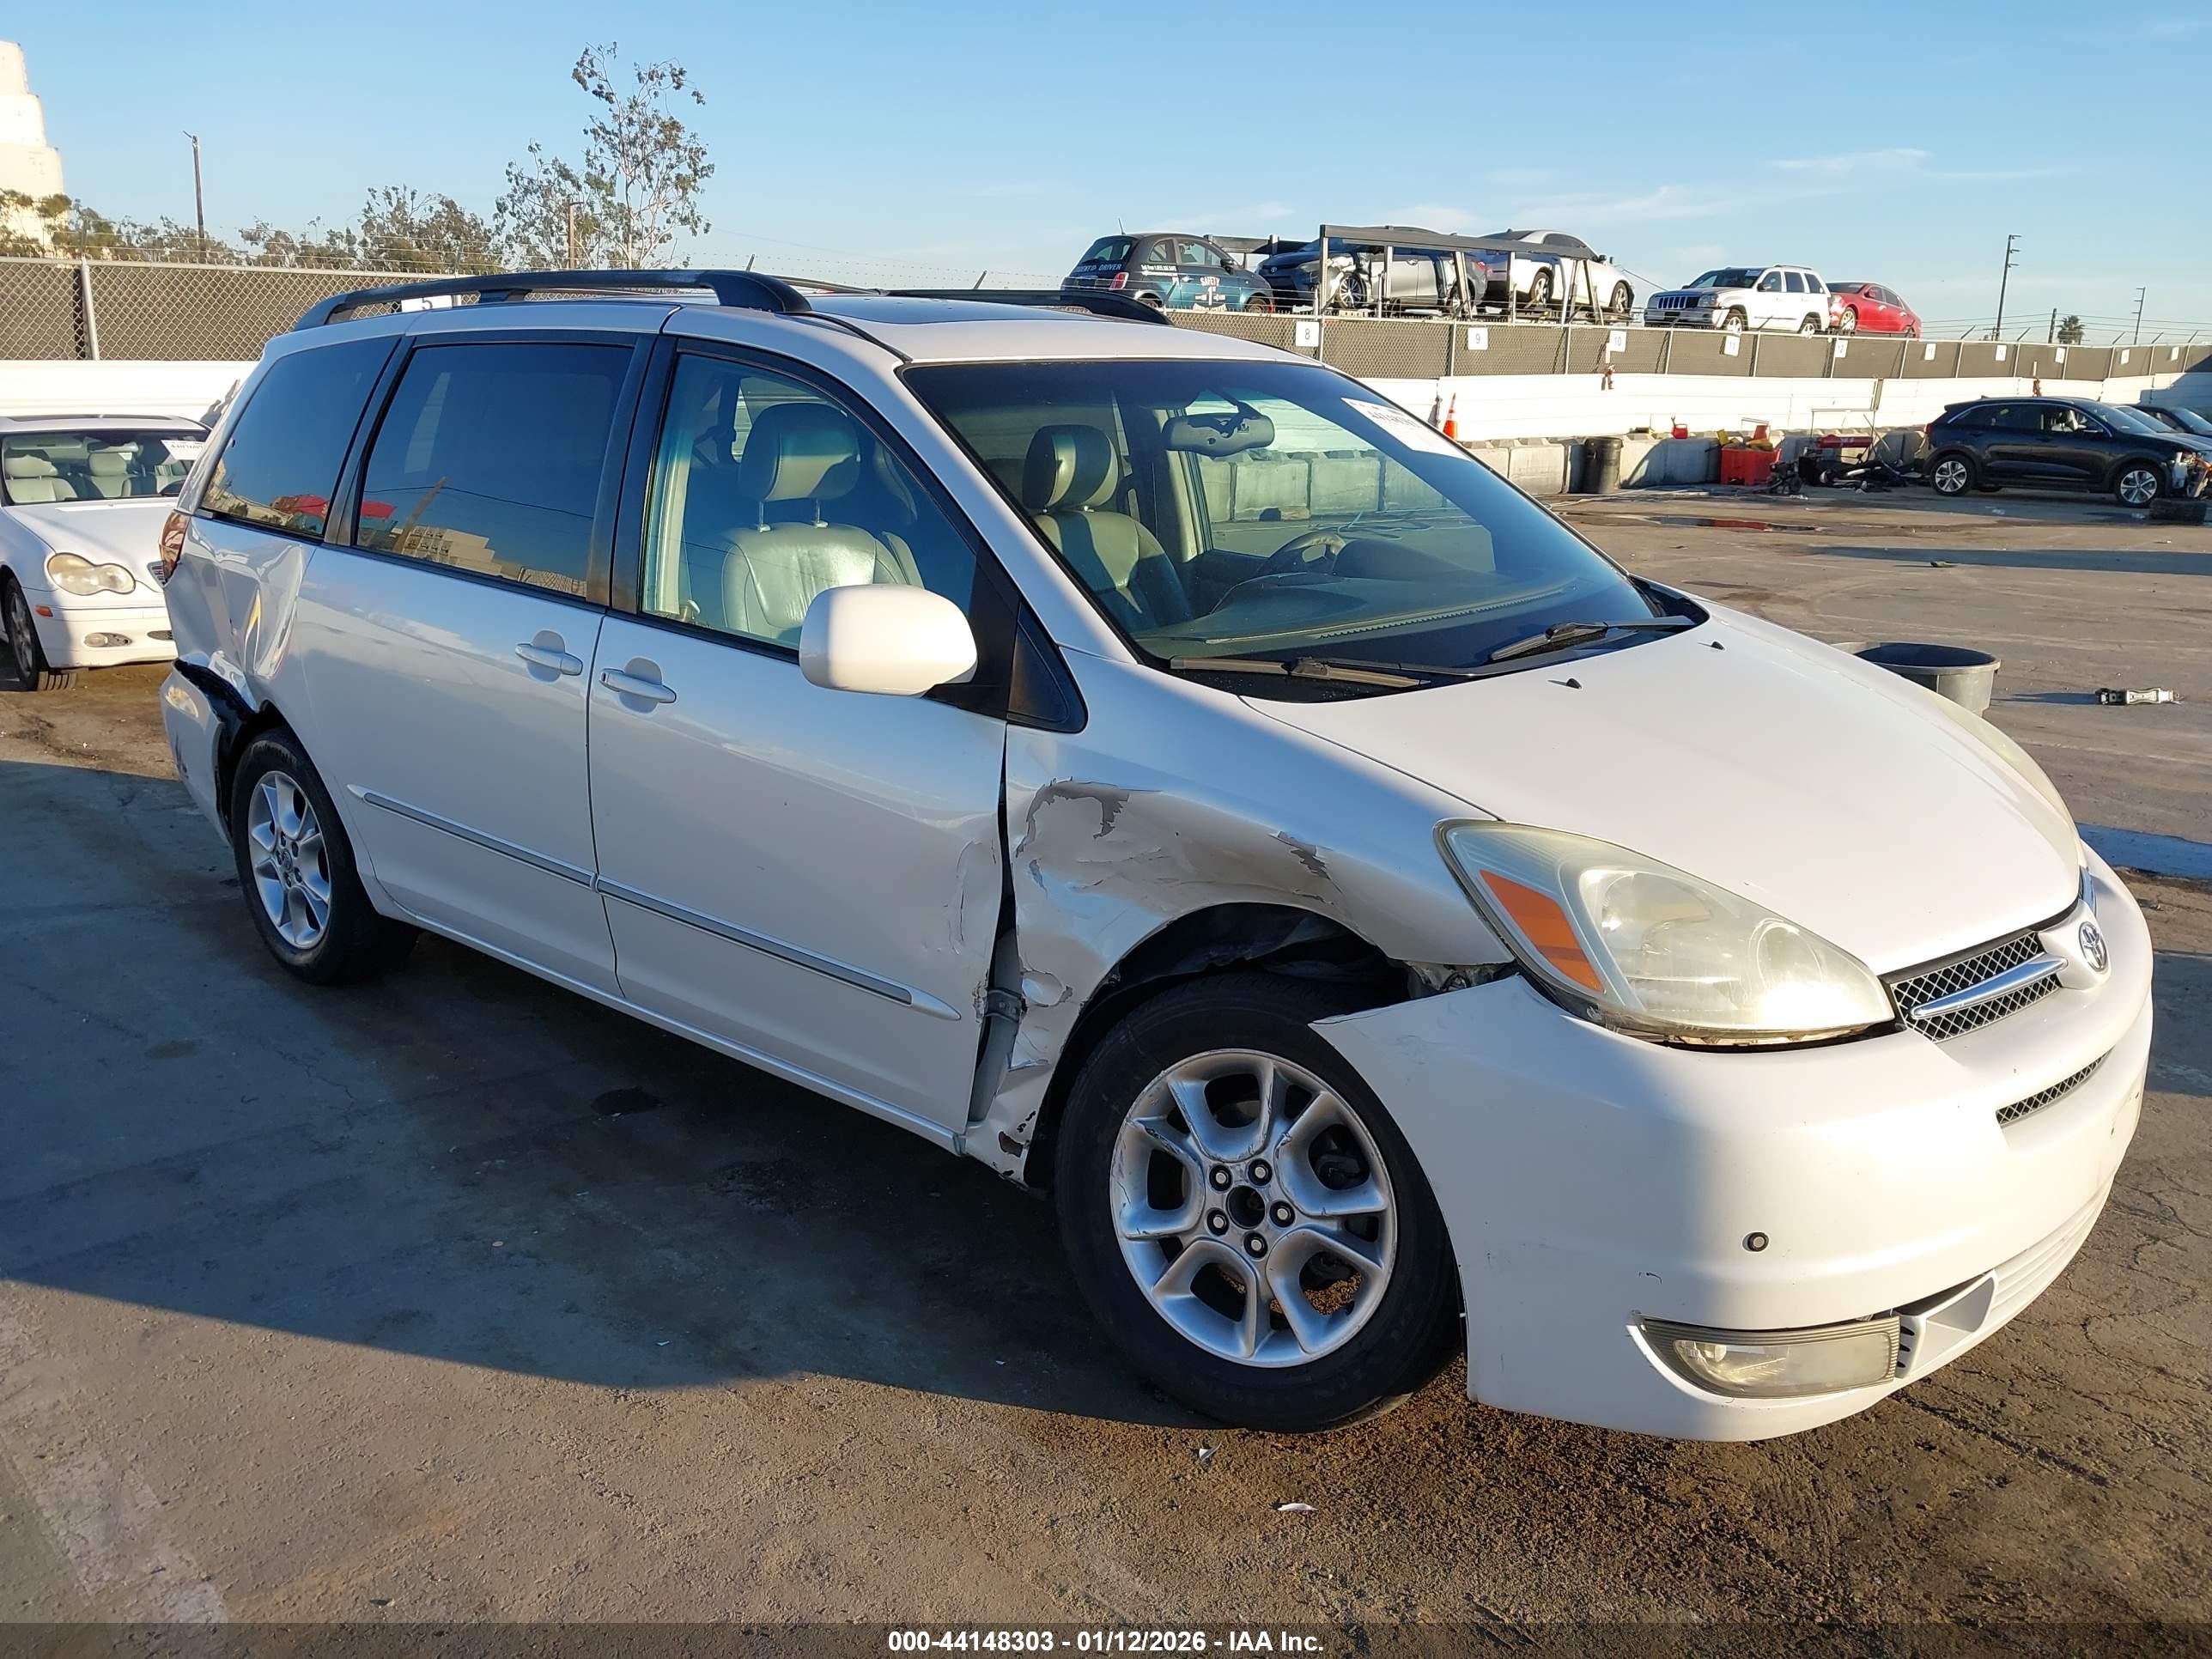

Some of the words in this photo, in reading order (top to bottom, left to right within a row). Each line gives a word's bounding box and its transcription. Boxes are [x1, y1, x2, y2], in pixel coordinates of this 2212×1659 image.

[1200, 276, 1220, 287] SAFETY
[1304, 327, 1310, 340] 8
[1475, 333, 1481, 344] 9
[1614, 336, 1622, 347] 10
[1729, 341, 1736, 350] 11
[1838, 343, 1844, 355] 12
